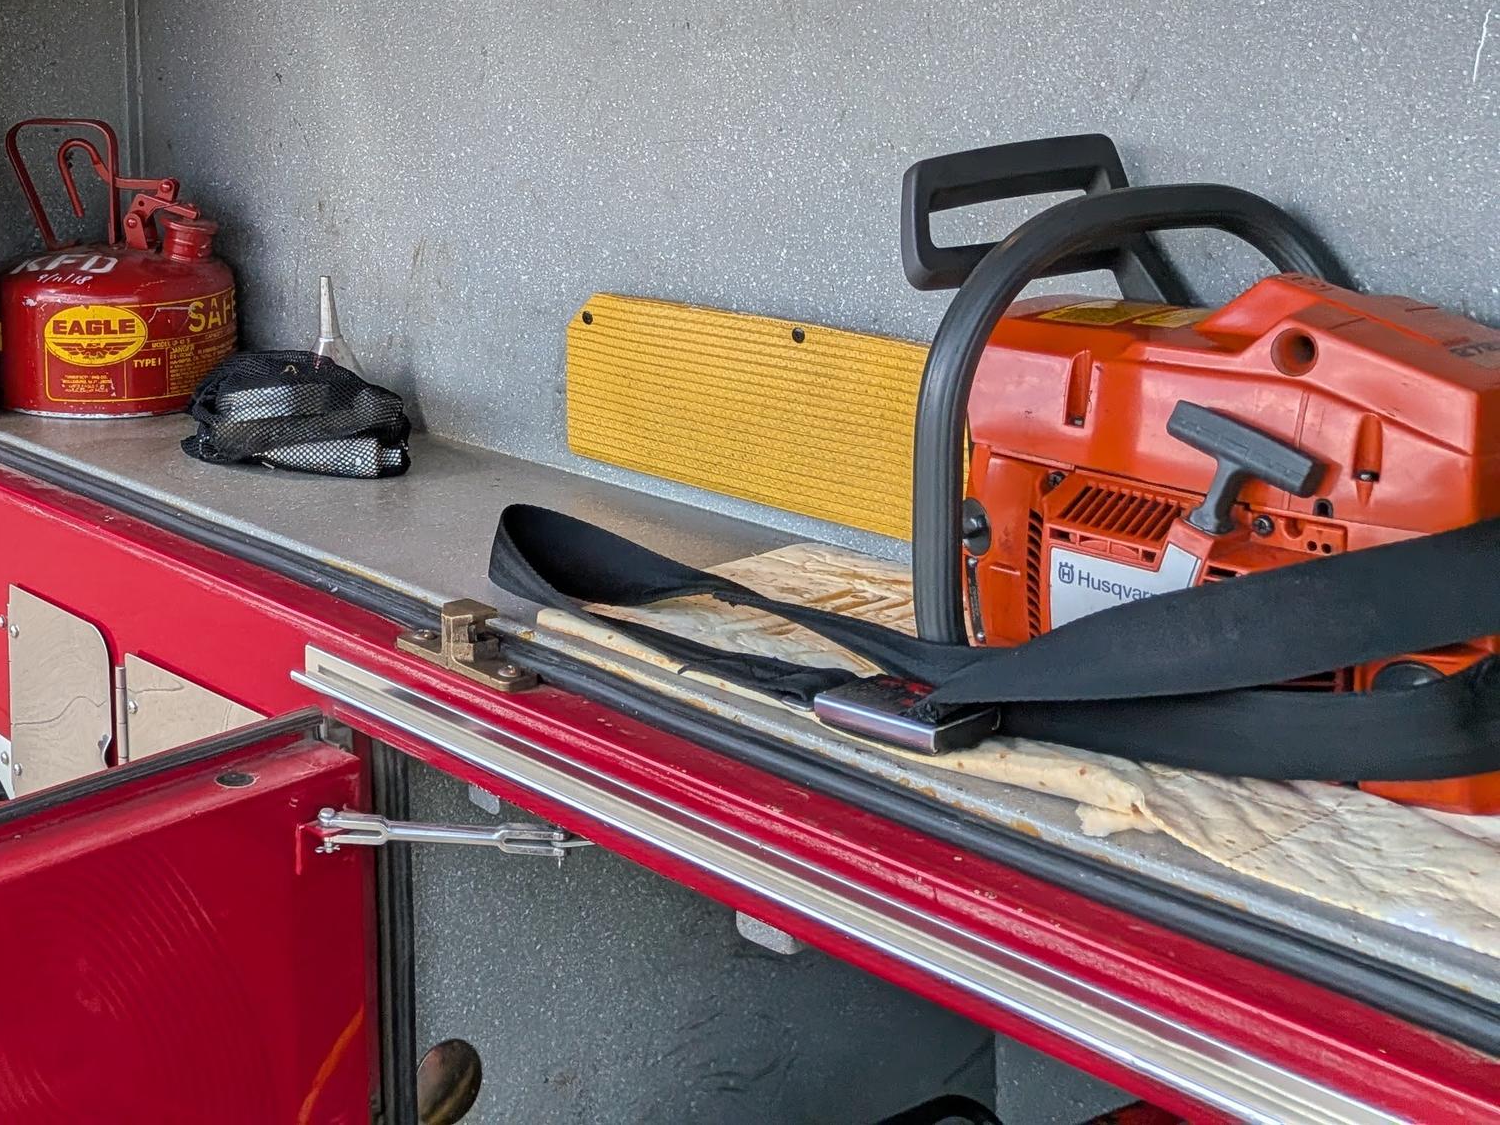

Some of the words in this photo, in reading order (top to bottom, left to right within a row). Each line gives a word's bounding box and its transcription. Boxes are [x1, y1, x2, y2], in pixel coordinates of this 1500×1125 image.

[10, 254, 119, 274] KFD
[52, 318, 136, 336] EAGLE
[133, 358, 156, 368] TYPE
[1078, 570, 1152, 600] Husqvar
